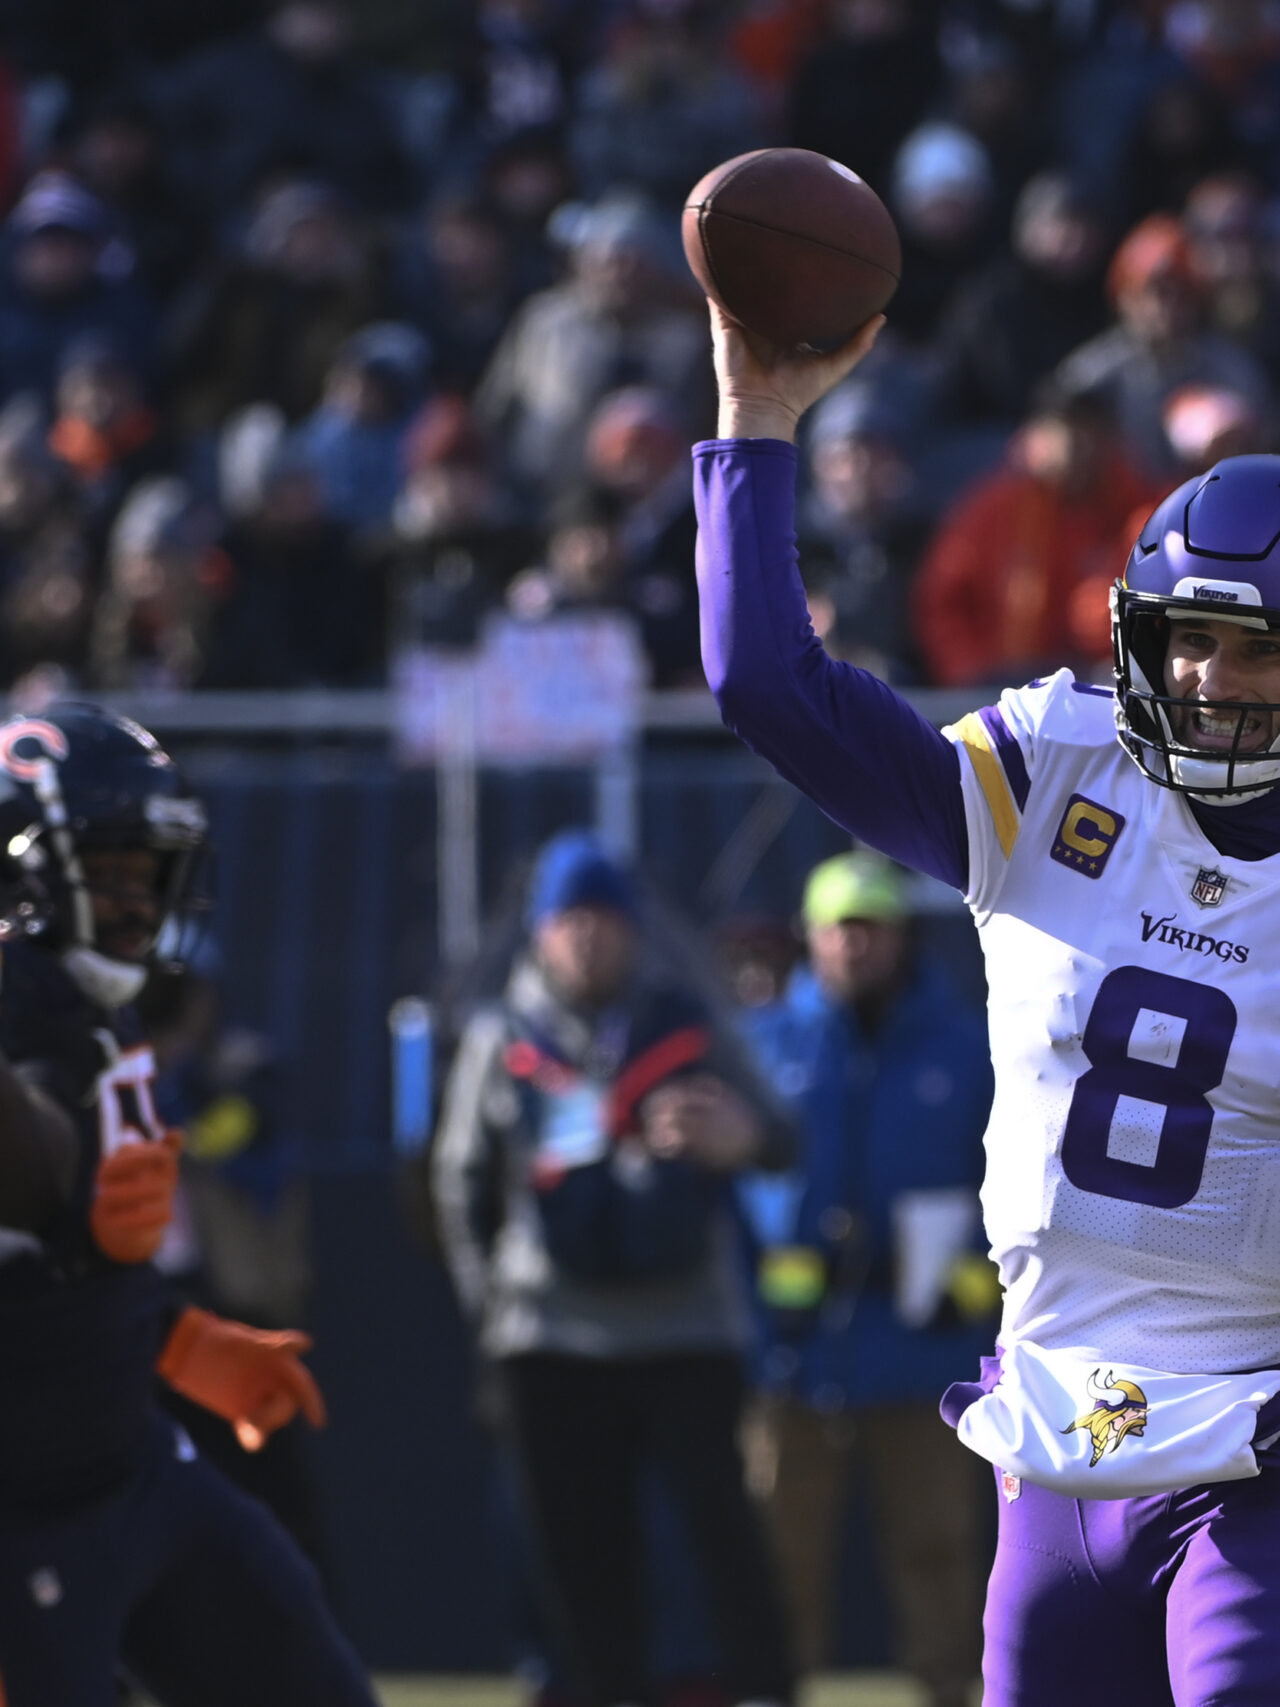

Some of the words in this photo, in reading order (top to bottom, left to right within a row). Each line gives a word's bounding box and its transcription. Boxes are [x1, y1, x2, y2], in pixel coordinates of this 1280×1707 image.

[1061, 801, 1116, 857] C
[1194, 882, 1219, 902] NFL
[1061, 965, 1237, 1209] 8
